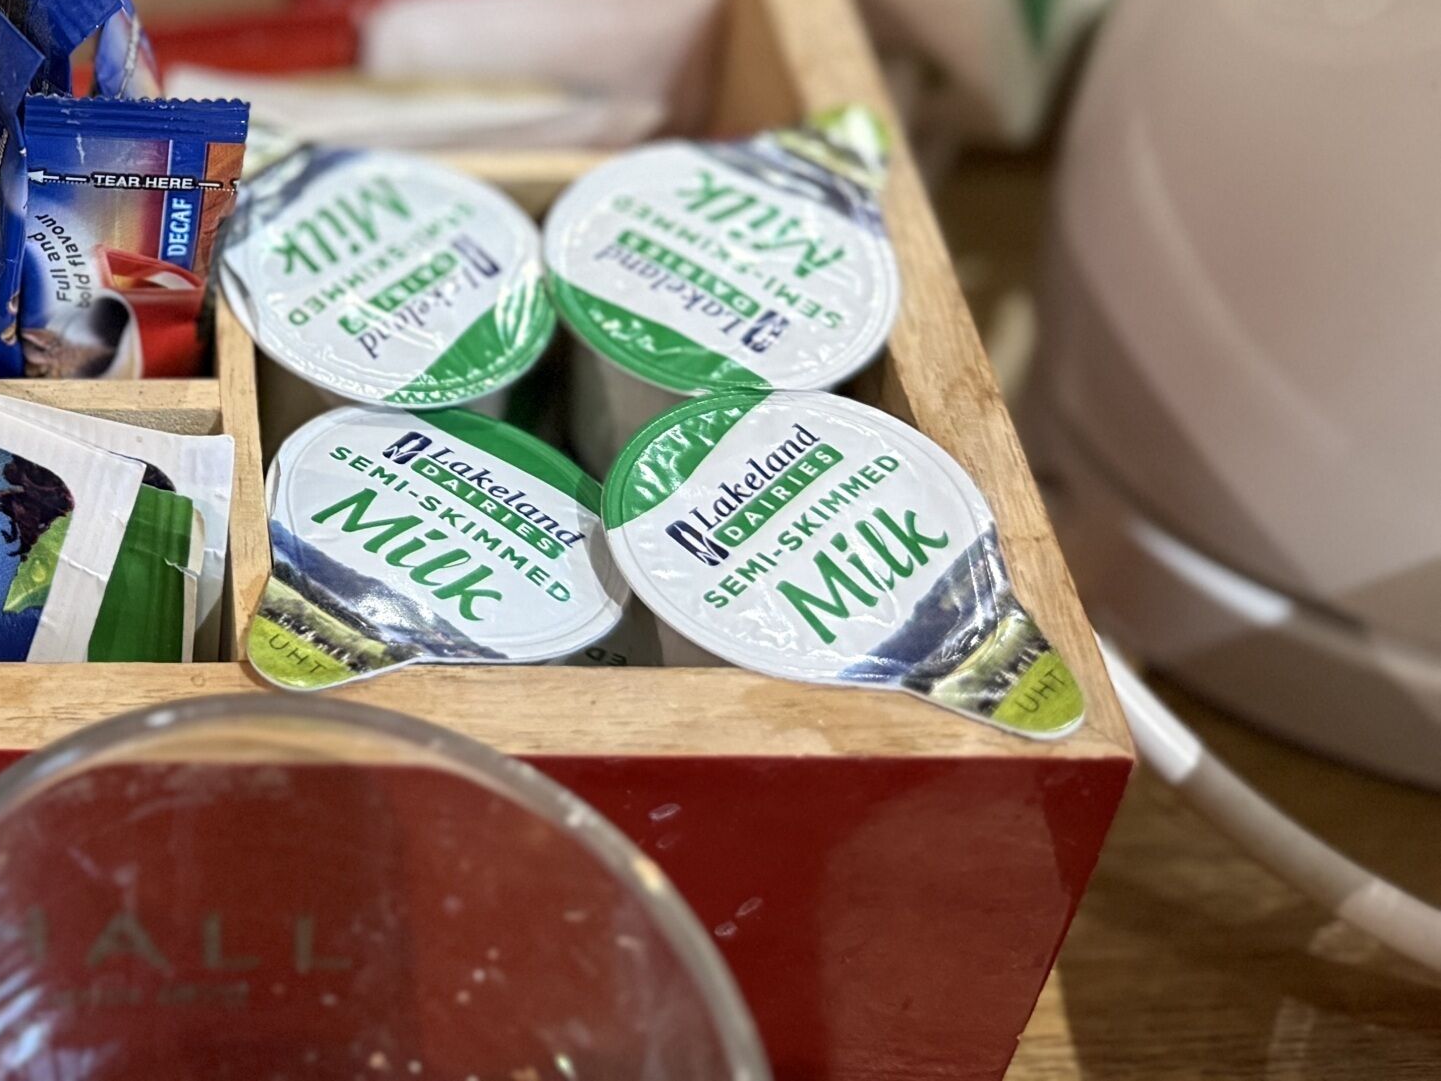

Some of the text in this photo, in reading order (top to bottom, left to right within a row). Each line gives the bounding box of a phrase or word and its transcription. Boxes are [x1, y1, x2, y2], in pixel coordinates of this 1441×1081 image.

[94, 174, 194, 190] TEAR HERE
[166, 197, 194, 257] DECAF
[271, 175, 412, 275] Milk
[675, 169, 846, 279] Milk
[28, 231, 72, 302] Full and
[35, 212, 86, 267] flavour
[594, 243, 744, 336] Lakeland
[421, 463, 553, 552] DAIRIES
[427, 444, 587, 549] Lakeland
[690, 423, 821, 531] Lakeland
[727, 449, 835, 542] DAIRIES
[311, 487, 503, 622] Milk
[330, 446, 572, 603] SEMI-SKIMMED
[703, 455, 900, 609] SEMI-SKIMMED
[776, 507, 949, 644] Milk
[268, 633, 328, 674] UHT
[1014, 670, 1069, 715] UHT
